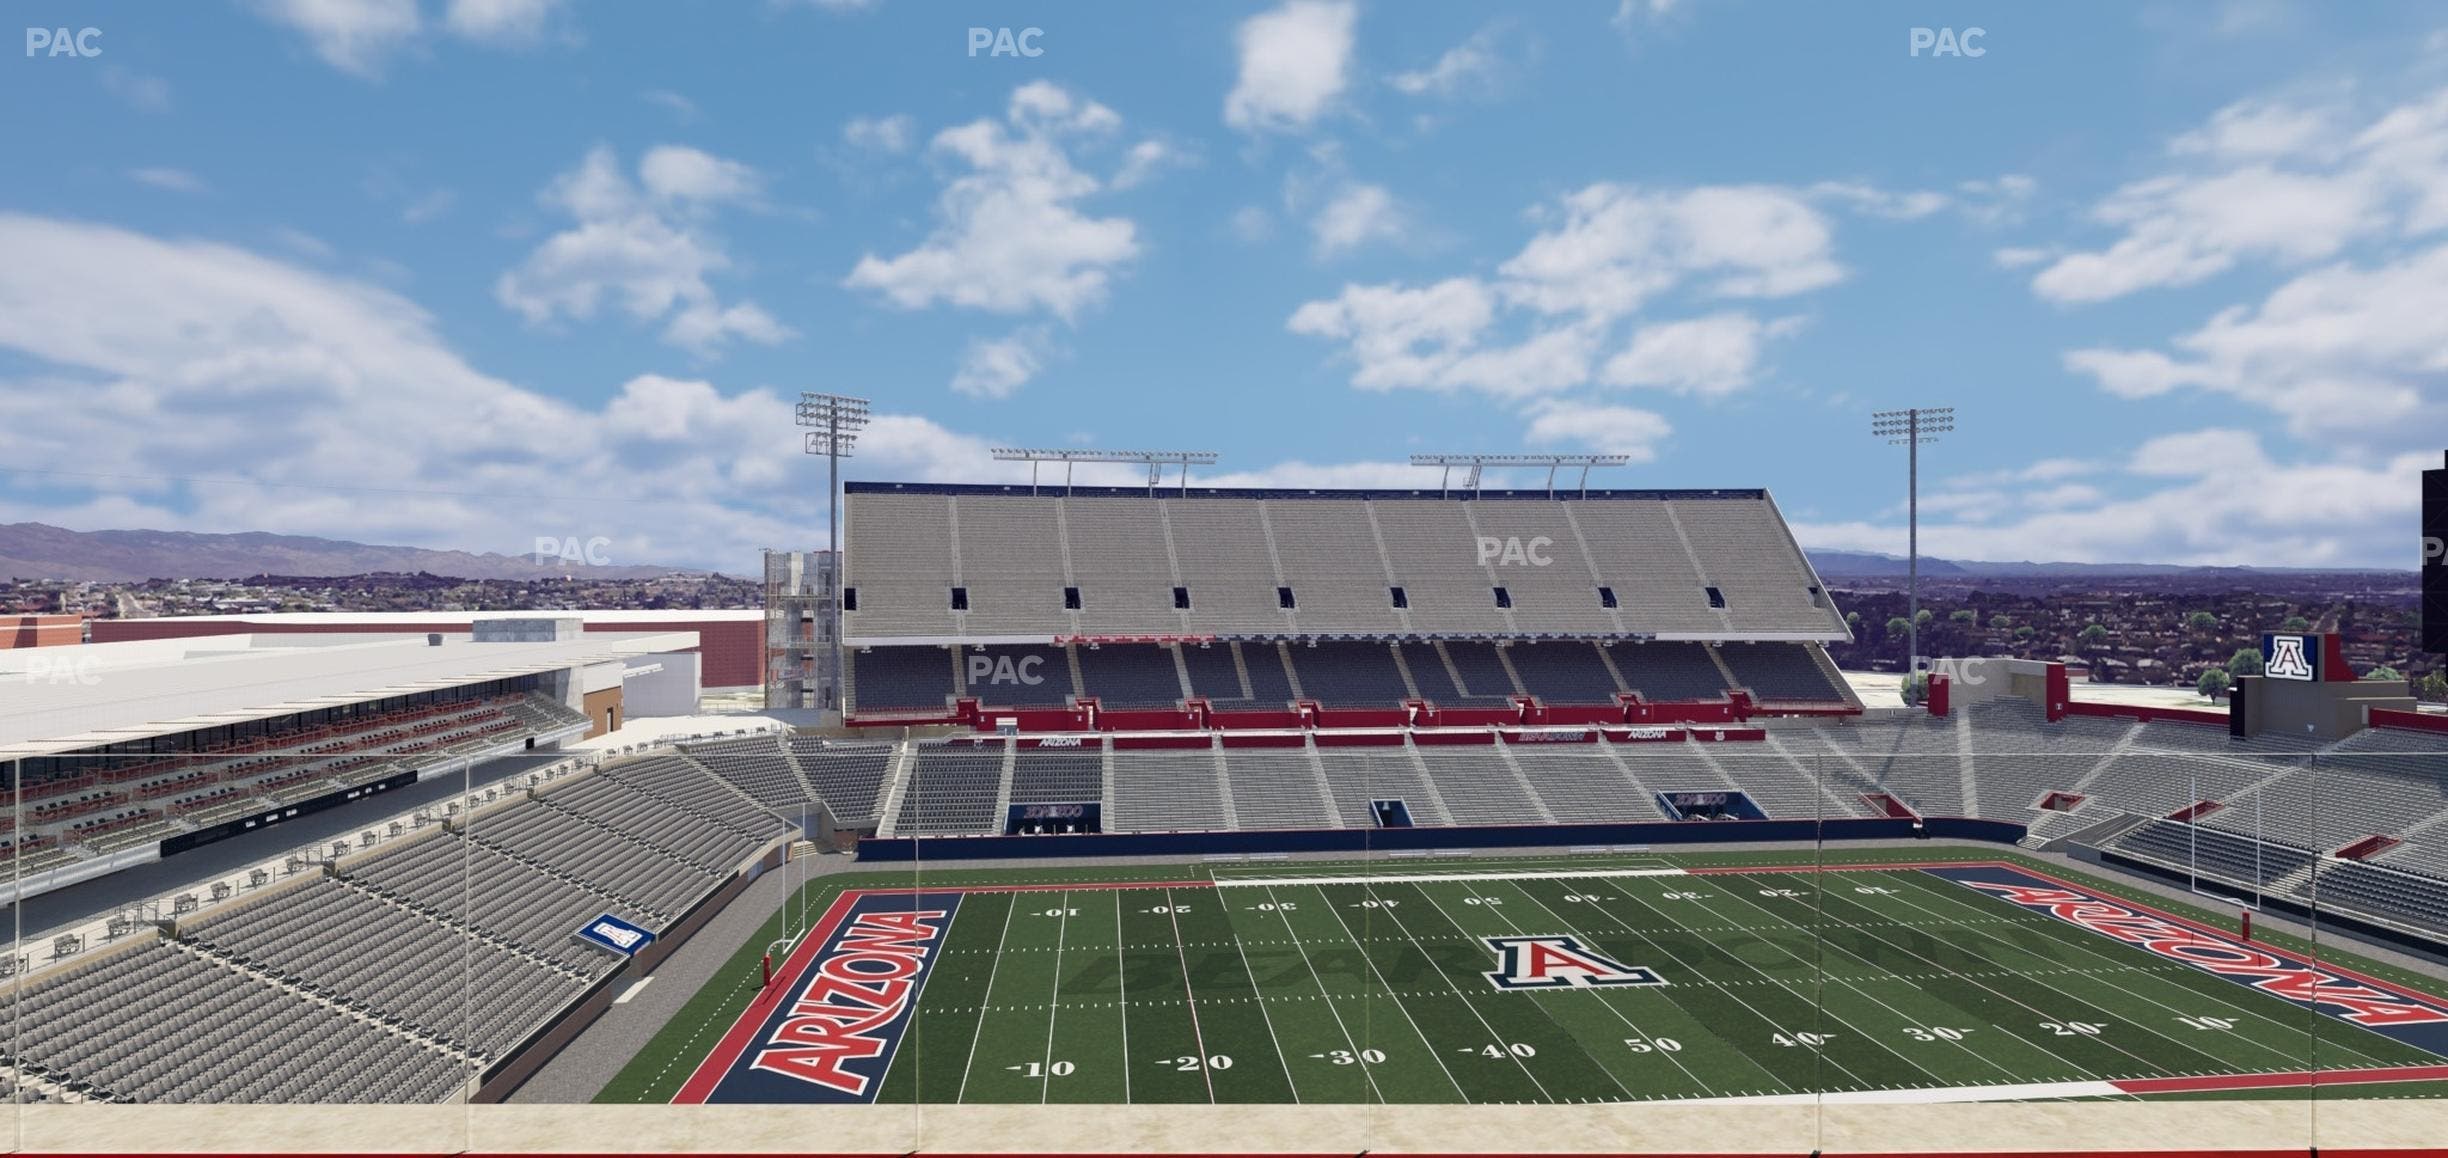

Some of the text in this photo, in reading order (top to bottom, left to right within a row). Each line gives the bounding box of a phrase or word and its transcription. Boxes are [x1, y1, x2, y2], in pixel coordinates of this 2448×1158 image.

[2265, 635, 2313, 681] A
[1039, 737, 1082, 747] ARIZONA
[1958, 880, 2448, 1026] ARIZONA
[1479, 934, 1671, 991] A
[749, 910, 948, 1096] ARIZONA
[2039, 1021, 2102, 1037] 20
[2172, 1016, 2234, 1031] 10
[1772, 1031, 1826, 1048] 40
[1902, 1026, 1964, 1042] 30
[1481, 1043, 1537, 1059] 40
[1624, 1037, 1682, 1053] 50
[1176, 1055, 1233, 1071] 20
[1329, 1049, 1386, 1065] 30
[1023, 1061, 1075, 1078] 10
